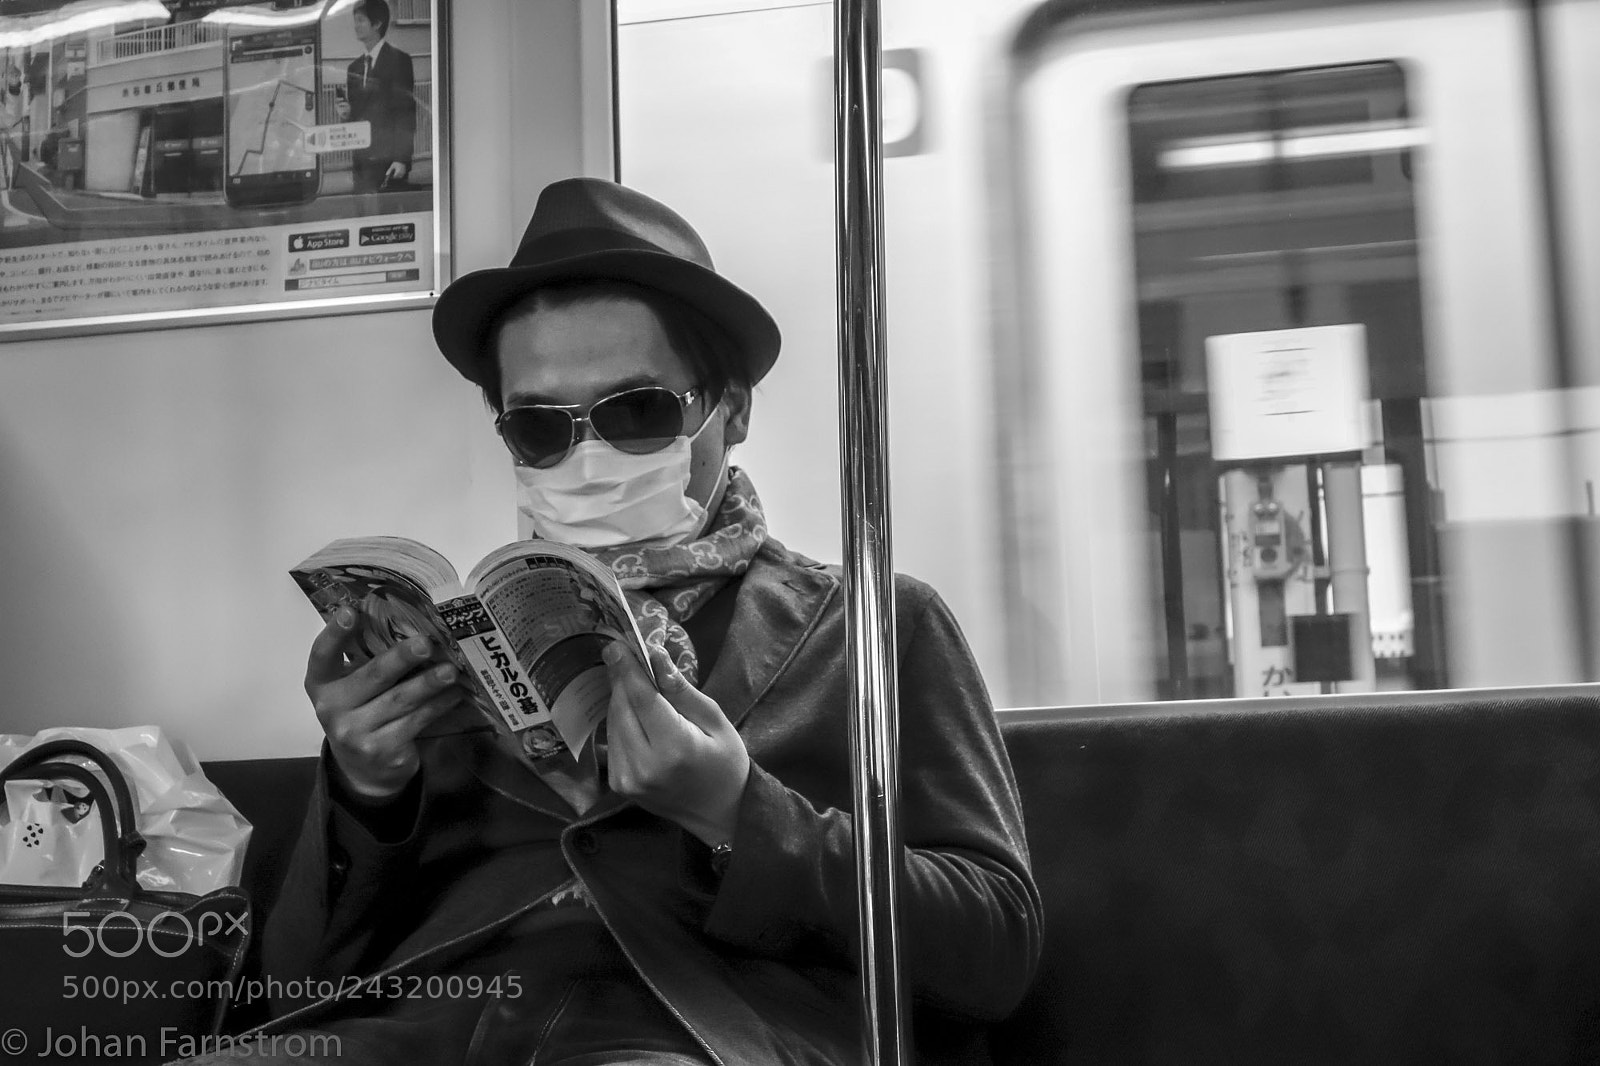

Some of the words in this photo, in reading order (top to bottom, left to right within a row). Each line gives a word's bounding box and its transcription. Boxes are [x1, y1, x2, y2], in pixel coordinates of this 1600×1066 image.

[307, 240, 323, 249] App
[324, 238, 345, 246] Store
[480, 636, 539, 715] ヒカルの碁
